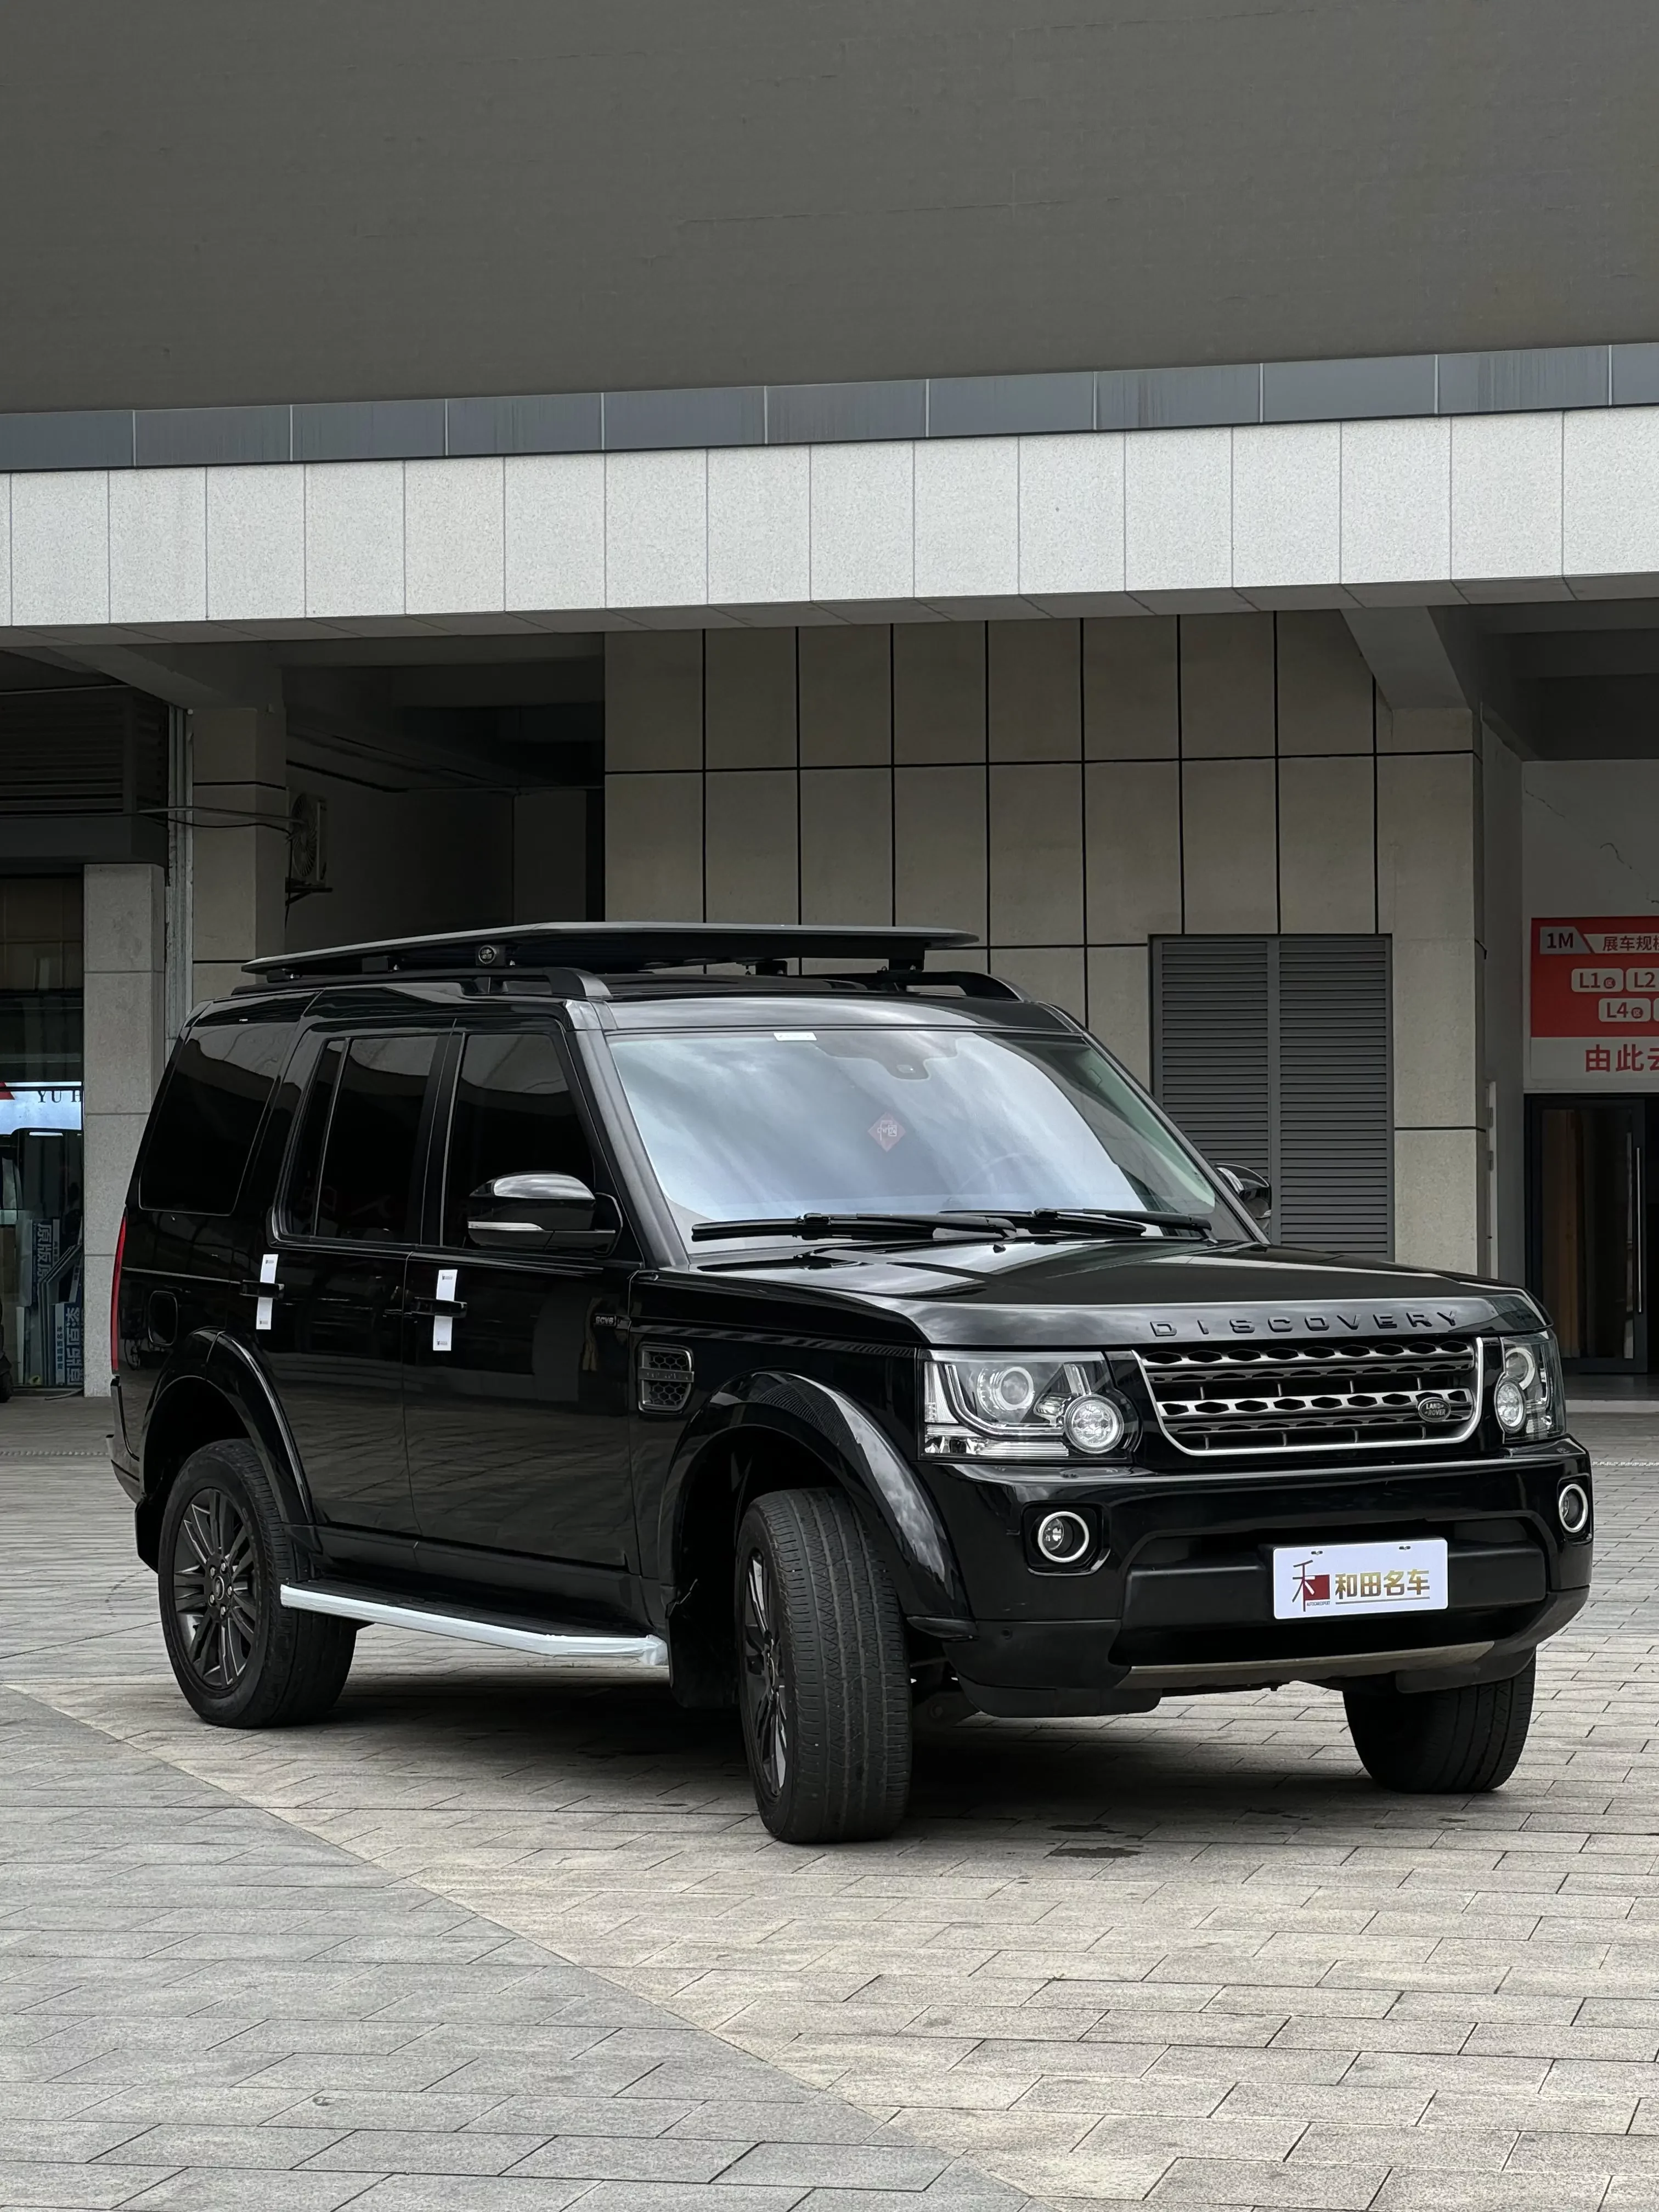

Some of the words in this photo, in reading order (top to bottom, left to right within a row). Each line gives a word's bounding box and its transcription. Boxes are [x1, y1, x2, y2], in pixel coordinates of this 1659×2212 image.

[1547, 933, 1573, 949] 1M
[1149, 1310, 1458, 1338] DISCOVERY
[1335, 1568, 1430, 1600] 和田名车
